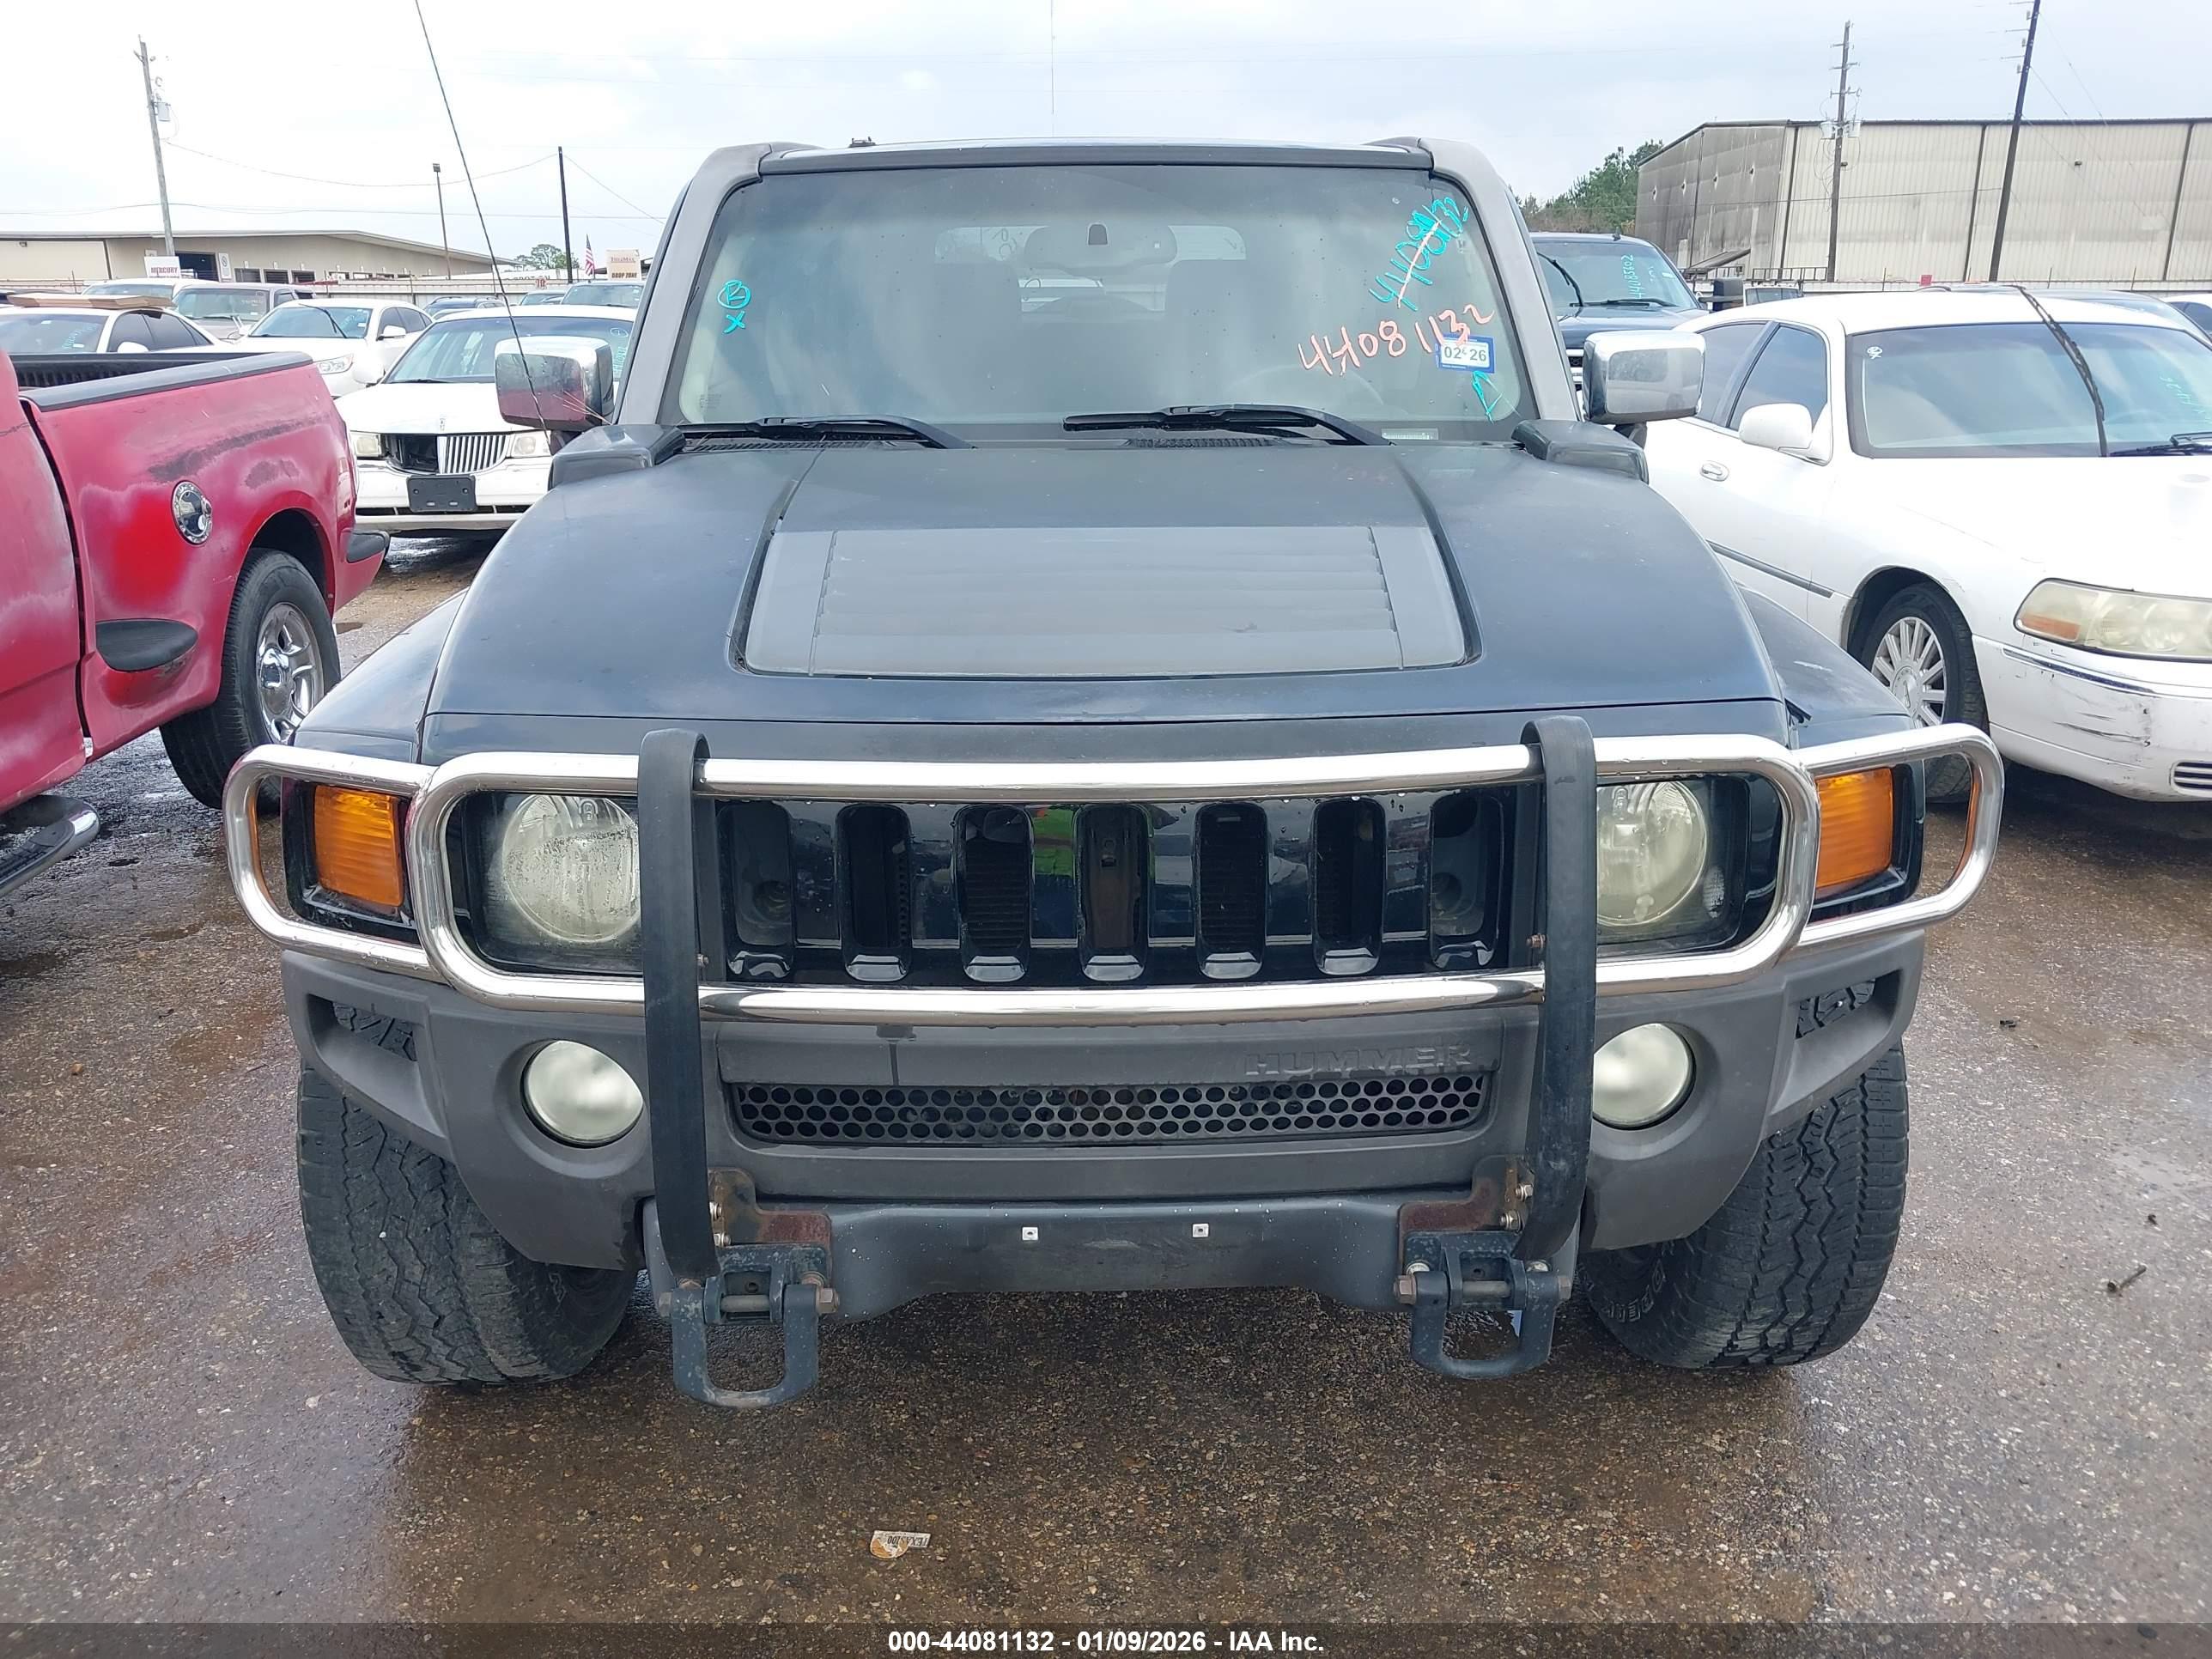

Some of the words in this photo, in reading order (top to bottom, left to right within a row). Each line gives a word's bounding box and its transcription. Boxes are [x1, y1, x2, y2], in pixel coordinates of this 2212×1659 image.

[1443, 346, 1462, 360] 02
[1469, 349, 1486, 362] 26
[1245, 1044, 1471, 1075] HUMMER
